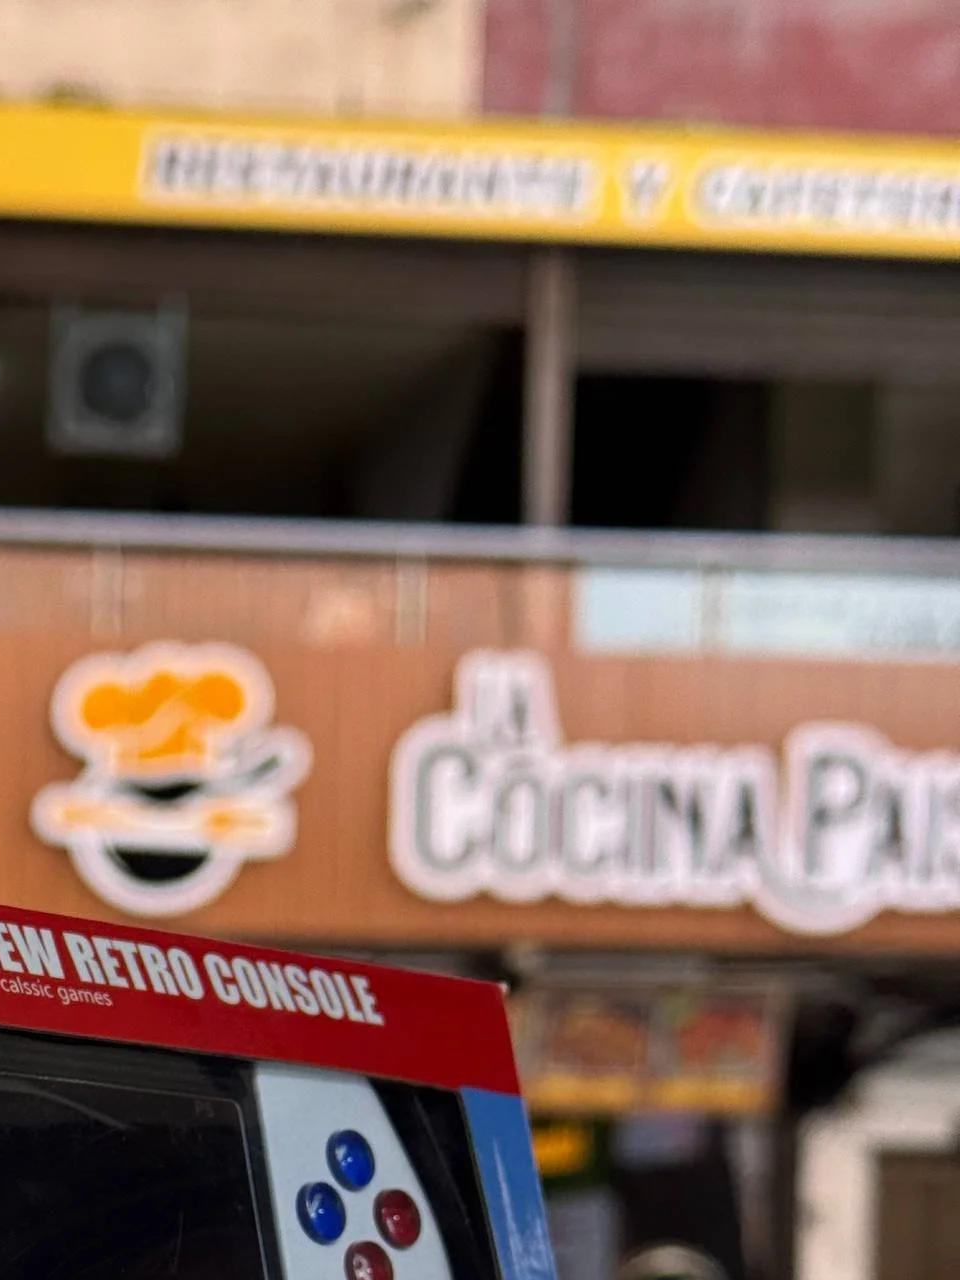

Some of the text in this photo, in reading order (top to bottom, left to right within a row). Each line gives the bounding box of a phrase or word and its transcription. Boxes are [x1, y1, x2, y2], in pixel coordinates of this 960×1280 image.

[0, 978, 53, 999] calssic
[56, 985, 114, 1007] games
[62, 931, 206, 1000] RETRO
[202, 953, 385, 1027] CONSOLE
